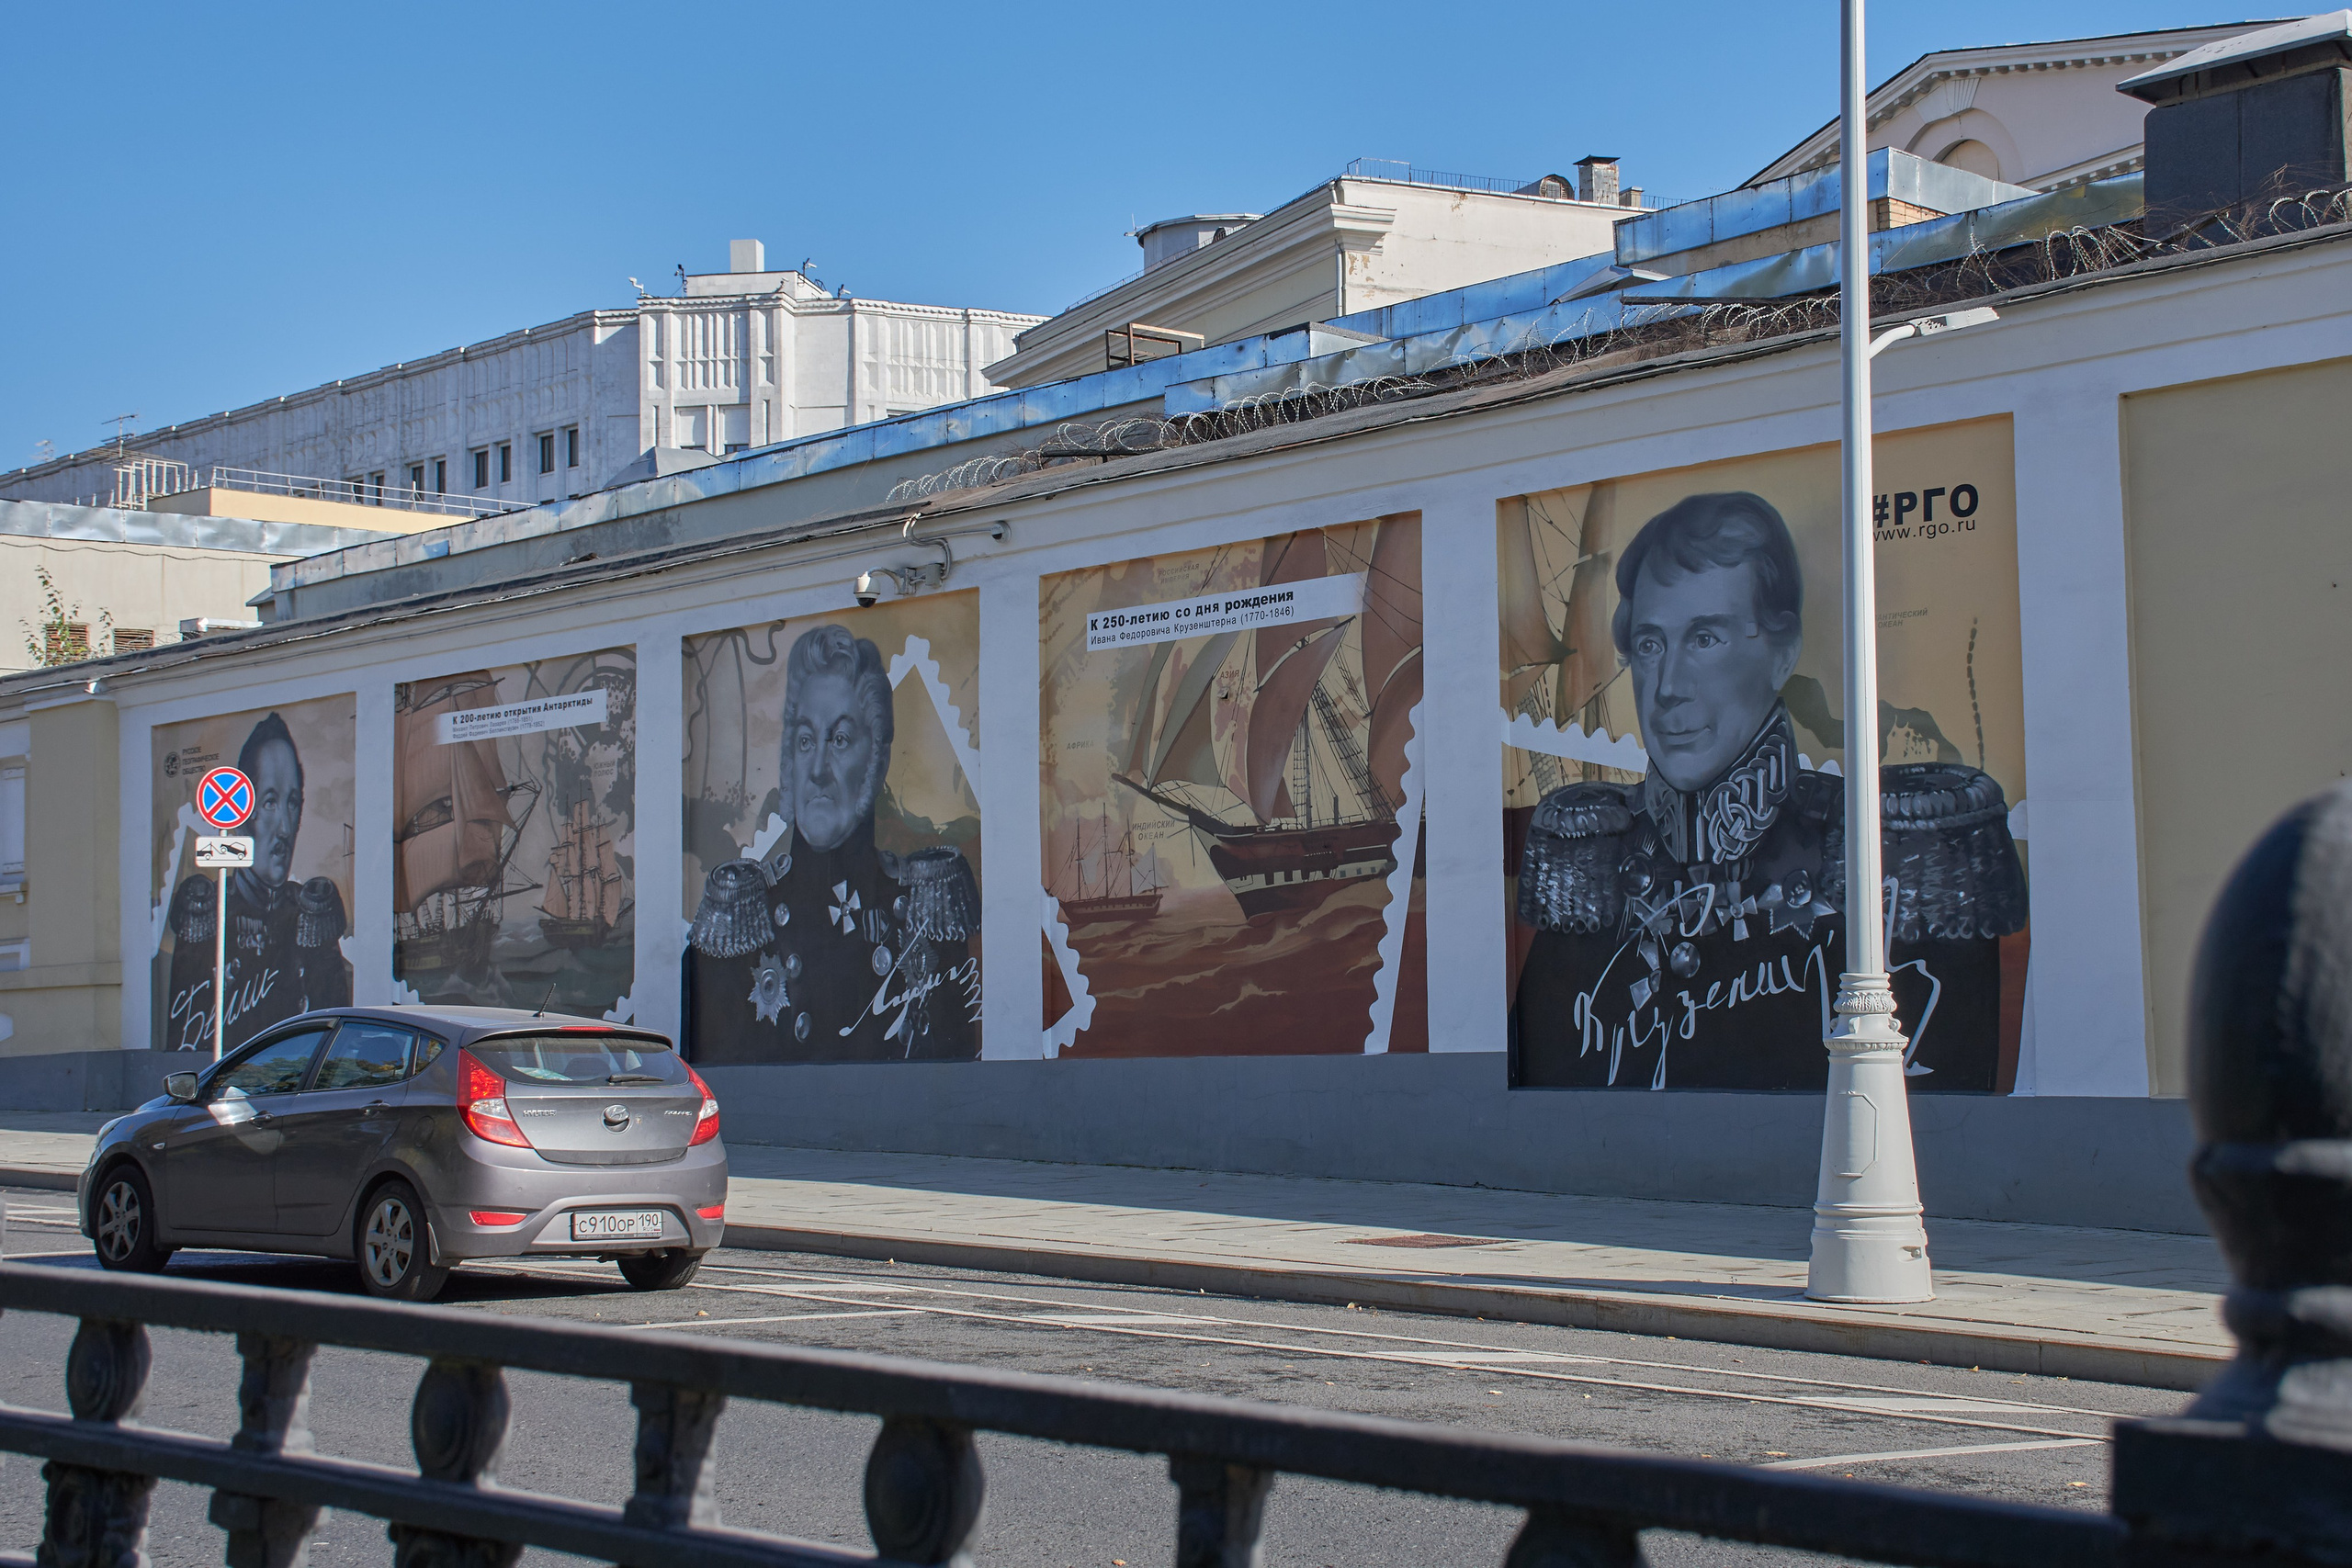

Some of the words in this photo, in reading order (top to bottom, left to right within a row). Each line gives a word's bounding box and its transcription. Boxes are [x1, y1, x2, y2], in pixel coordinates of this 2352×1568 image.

[1872, 483, 1979, 528] #РГО
[1090, 619, 1098, 631] К
[1102, 611, 1170, 629] 250-летию
[1175, 607, 1191, 618] со
[1195, 603, 1219, 617] дня
[1225, 591, 1294, 614] рождения
[1876, 607, 1928, 621] АНТИЧЕСКИЙ
[1091, 635, 1116, 645] Ивана
[1119, 626, 1170, 641] Федоровича
[1173, 616, 1237, 635] Крузенштерна
[1240, 605, 1295, 626] (1770-1846)
[1877, 619, 1904, 628] ОКЕАН
[1220, 670, 1239, 679] АЗИЯ
[453, 716, 458, 725] К
[460, 711, 502, 724] 200-летию
[504, 705, 542, 718] открытия
[543, 697, 593, 712] Антарктиды
[1067, 740, 1094, 750] АФРИКА
[1132, 819, 1175, 831] ИНДИЙСКИЙ
[1138, 831, 1164, 840] ОКЕАН
[639, 1213, 659, 1227] 190
